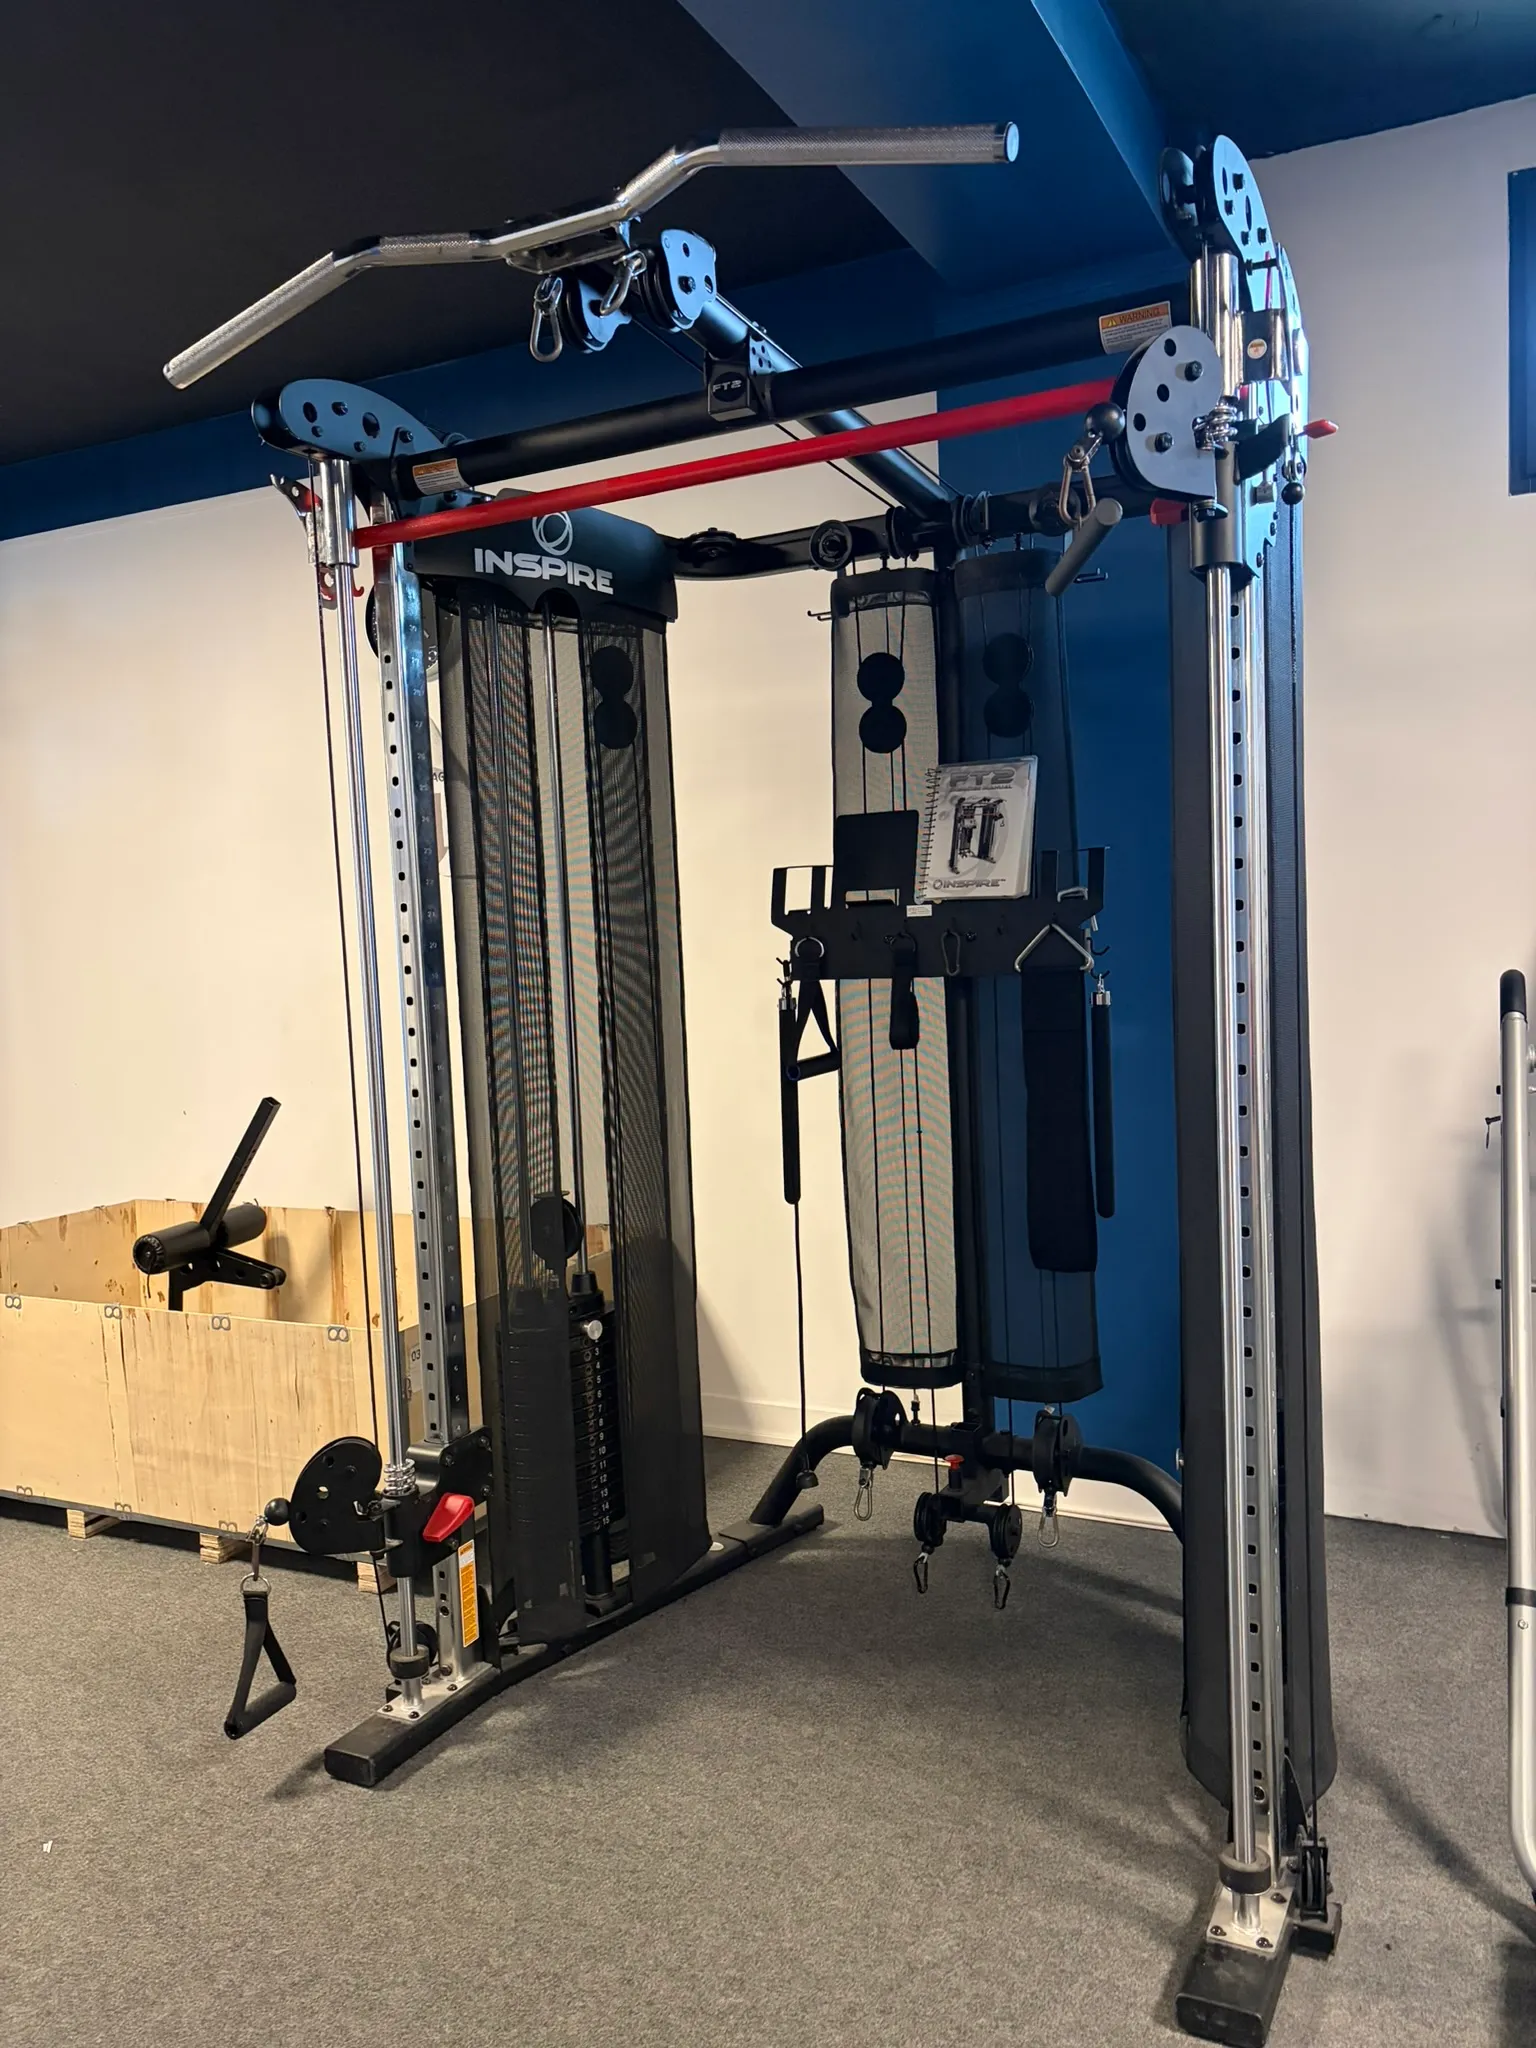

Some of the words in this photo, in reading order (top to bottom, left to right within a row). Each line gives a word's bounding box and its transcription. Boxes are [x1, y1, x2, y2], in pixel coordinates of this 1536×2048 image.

[1119, 307, 1160, 323] WARNING
[474, 548, 614, 595] INSPIRE
[949, 769, 1015, 788] FT2
[943, 879, 1000, 888] INSPIRE
[599, 1446, 606, 1455] 10
[600, 1460, 607, 1469] 11
[600, 1474, 607, 1483] 12
[601, 1488, 608, 1498] 13
[602, 1502, 609, 1511] 14
[602, 1516, 610, 1525] 15
